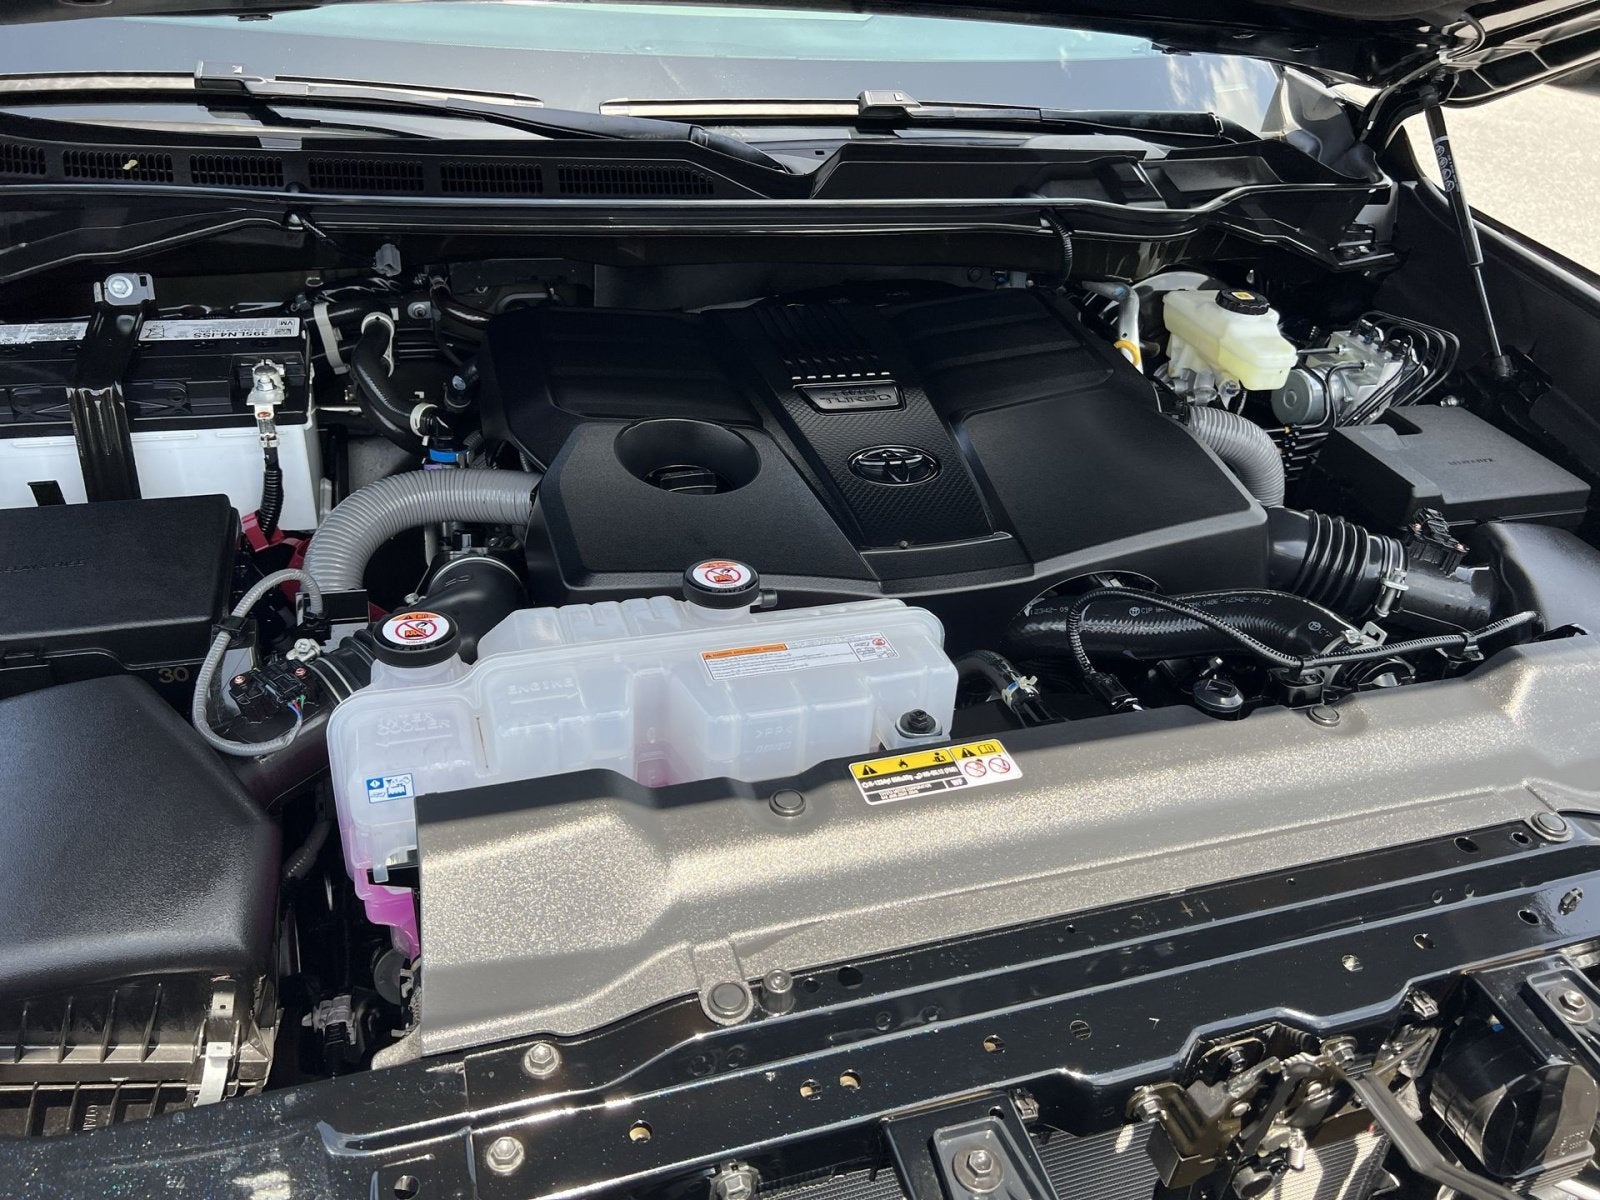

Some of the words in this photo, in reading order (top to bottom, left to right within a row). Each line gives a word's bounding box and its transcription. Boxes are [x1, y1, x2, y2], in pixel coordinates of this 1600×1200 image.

[819, 393, 892, 404] TURBO
[157, 666, 190, 683] 30
[507, 677, 574, 695] ENGINE
